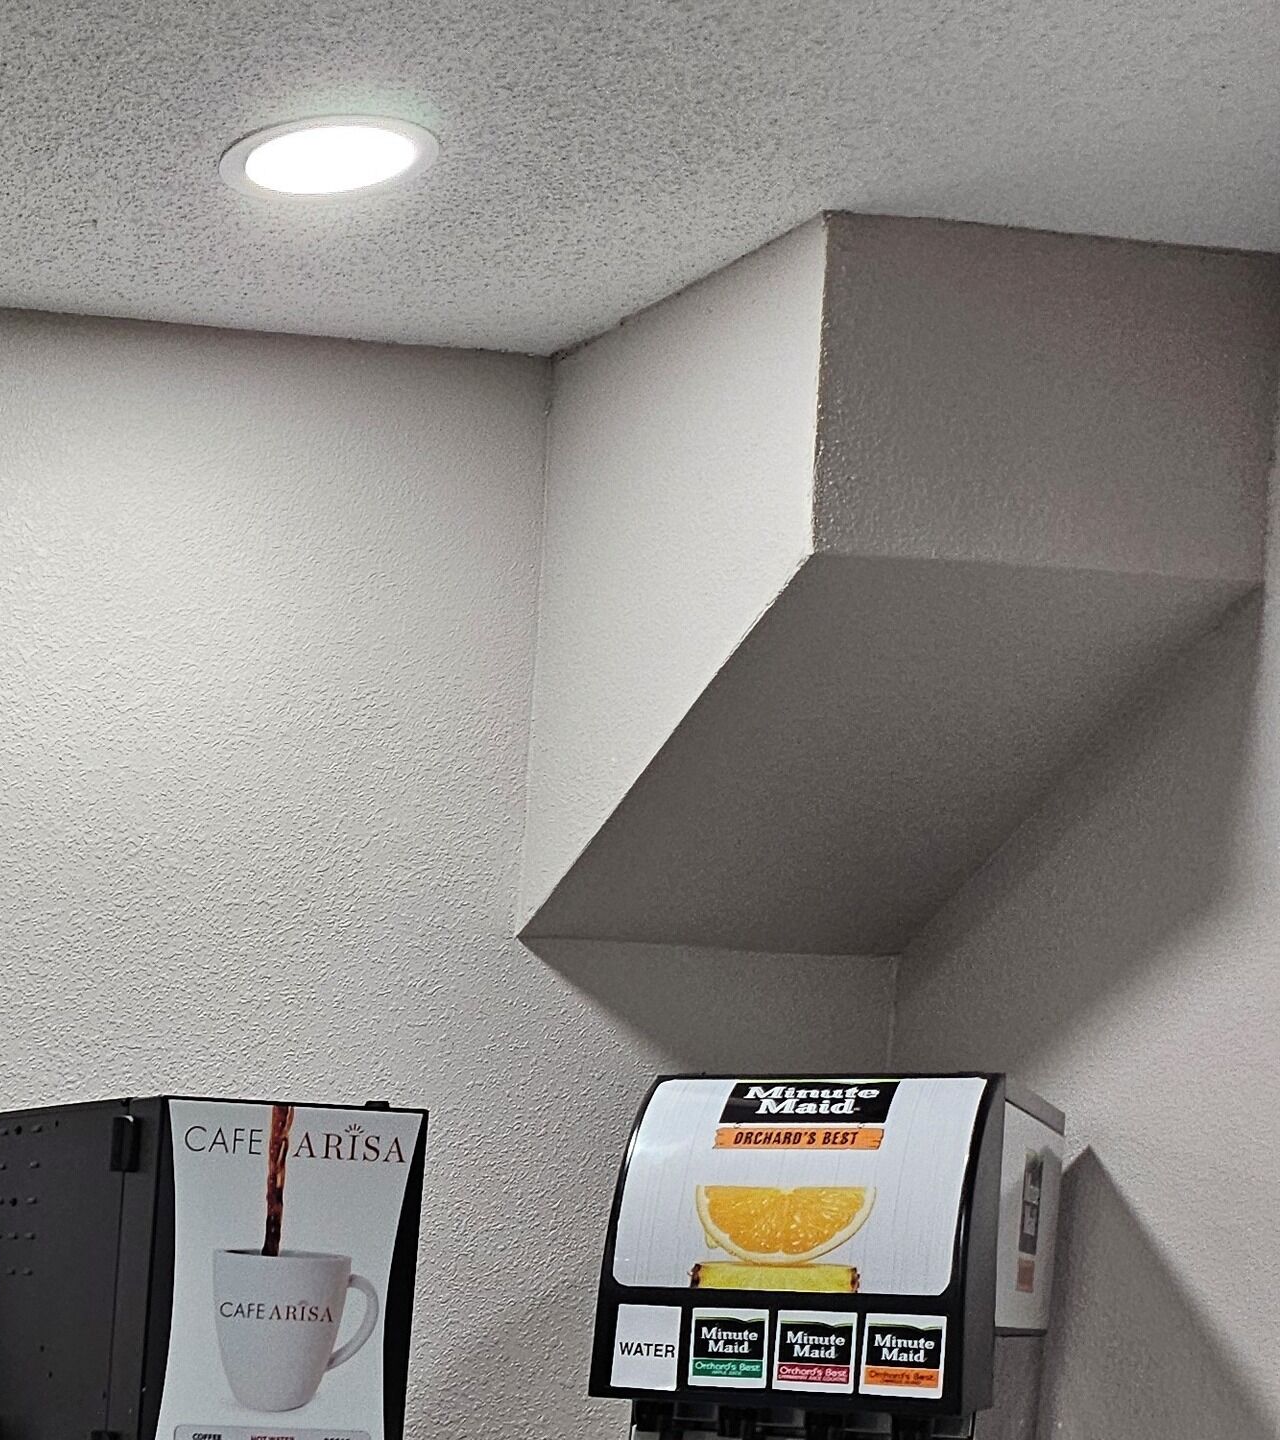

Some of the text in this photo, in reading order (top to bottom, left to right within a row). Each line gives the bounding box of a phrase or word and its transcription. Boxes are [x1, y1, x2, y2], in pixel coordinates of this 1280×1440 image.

[743, 1086, 880, 1099] Minute
[755, 1099, 855, 1114] Maid
[184, 1125, 406, 1163] CAFE ARISA
[733, 1131, 858, 1145] ORCHARD'S BEST
[220, 1302, 334, 1323] CAFE ARISA
[701, 1326, 758, 1341] Minute
[786, 1330, 845, 1346] Minute
[707, 1340, 750, 1354] Maid
[873, 1334, 935, 1349] Minute
[619, 1341, 675, 1358] WATER
[792, 1344, 836, 1359] Maid
[881, 1348, 925, 1362] Maid
[695, 1361, 737, 1371] Orchard's
[779, 1366, 822, 1376] Orchard's
